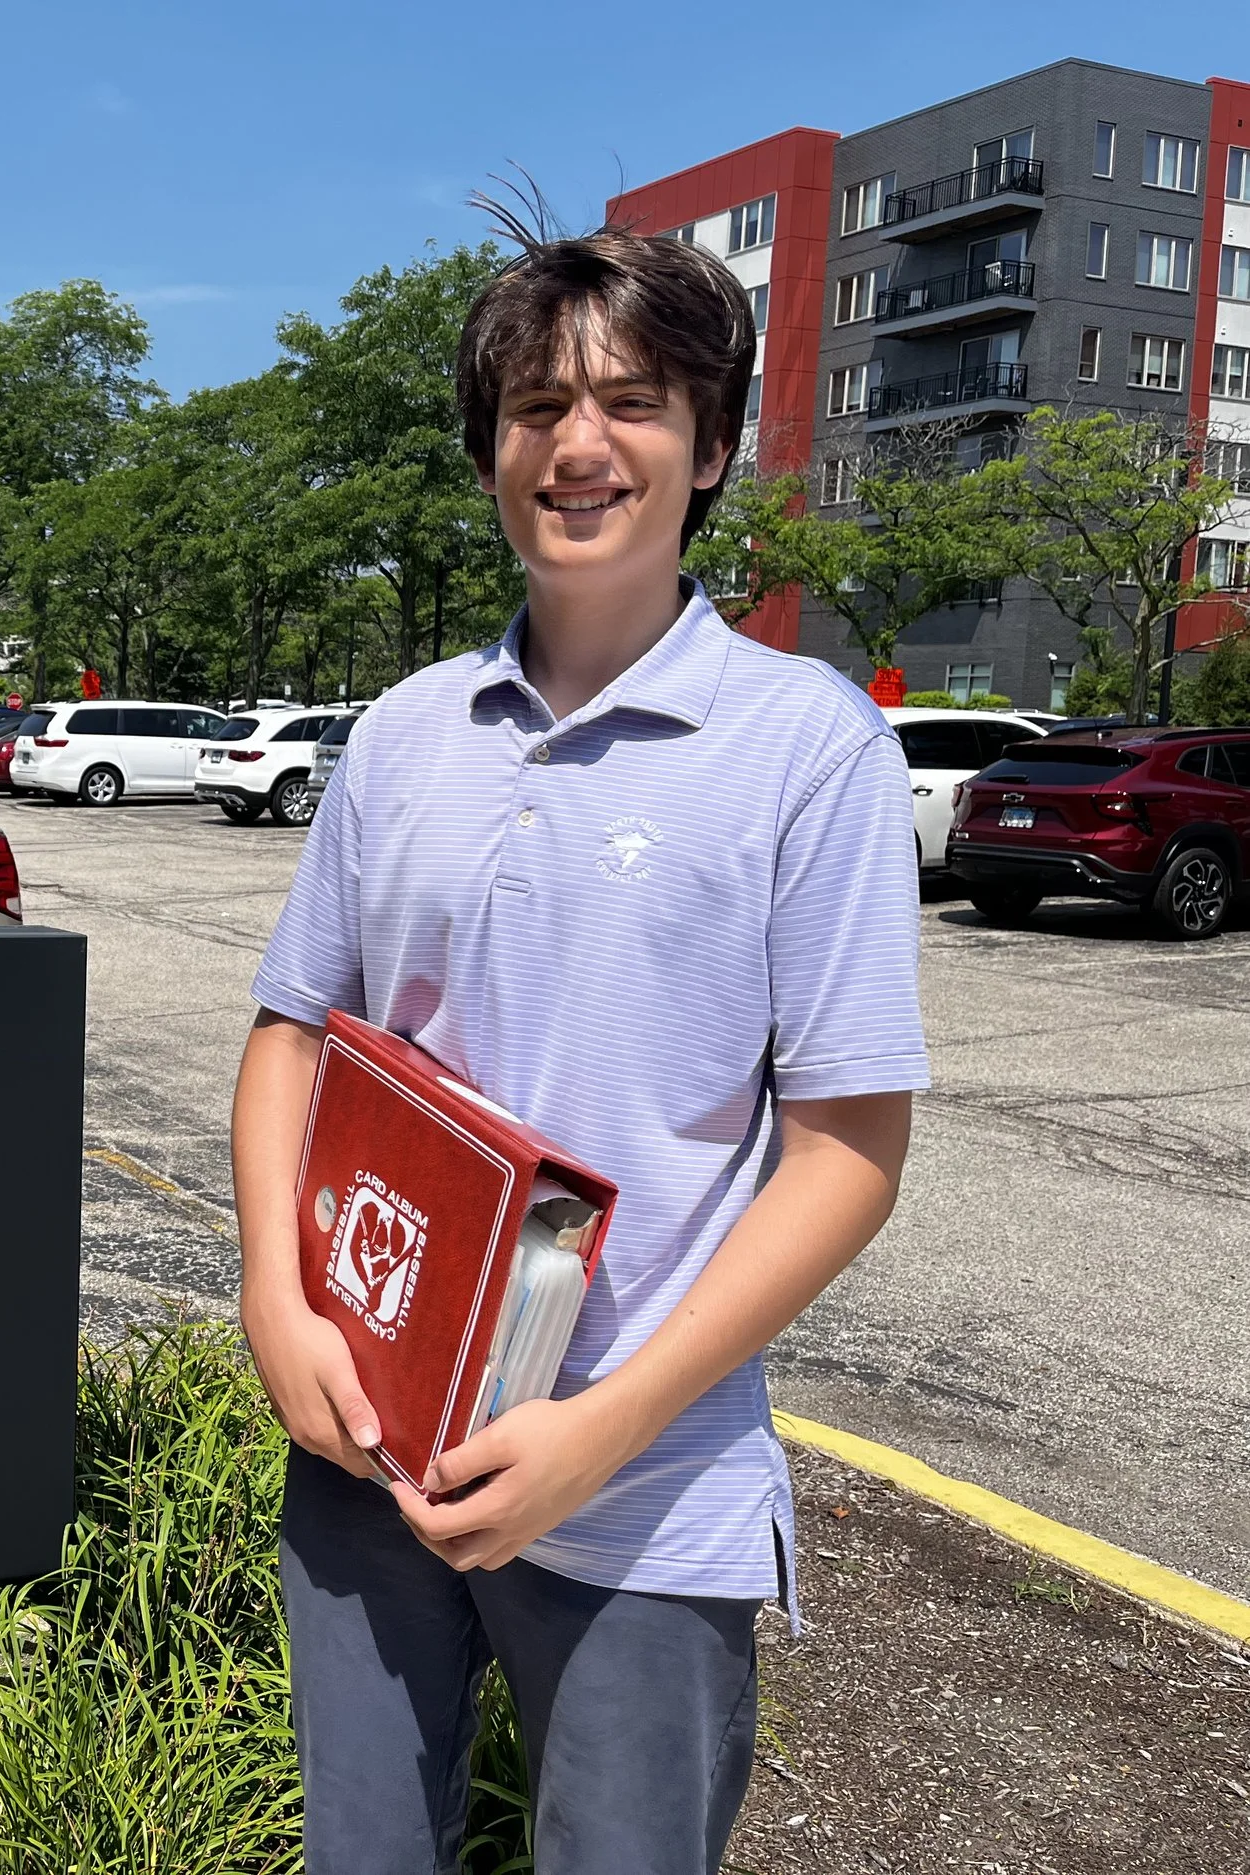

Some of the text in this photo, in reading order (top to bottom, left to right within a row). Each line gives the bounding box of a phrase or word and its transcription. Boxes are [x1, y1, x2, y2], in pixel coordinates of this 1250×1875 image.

[7, 697, 21, 706] STOP
[325, 1184, 356, 1276] BASEBALL
[354, 1169, 430, 1230] CARD ALBUM
[325, 1276, 397, 1342] CARD ALBUM
[396, 1230, 428, 1329] BASEBALL
